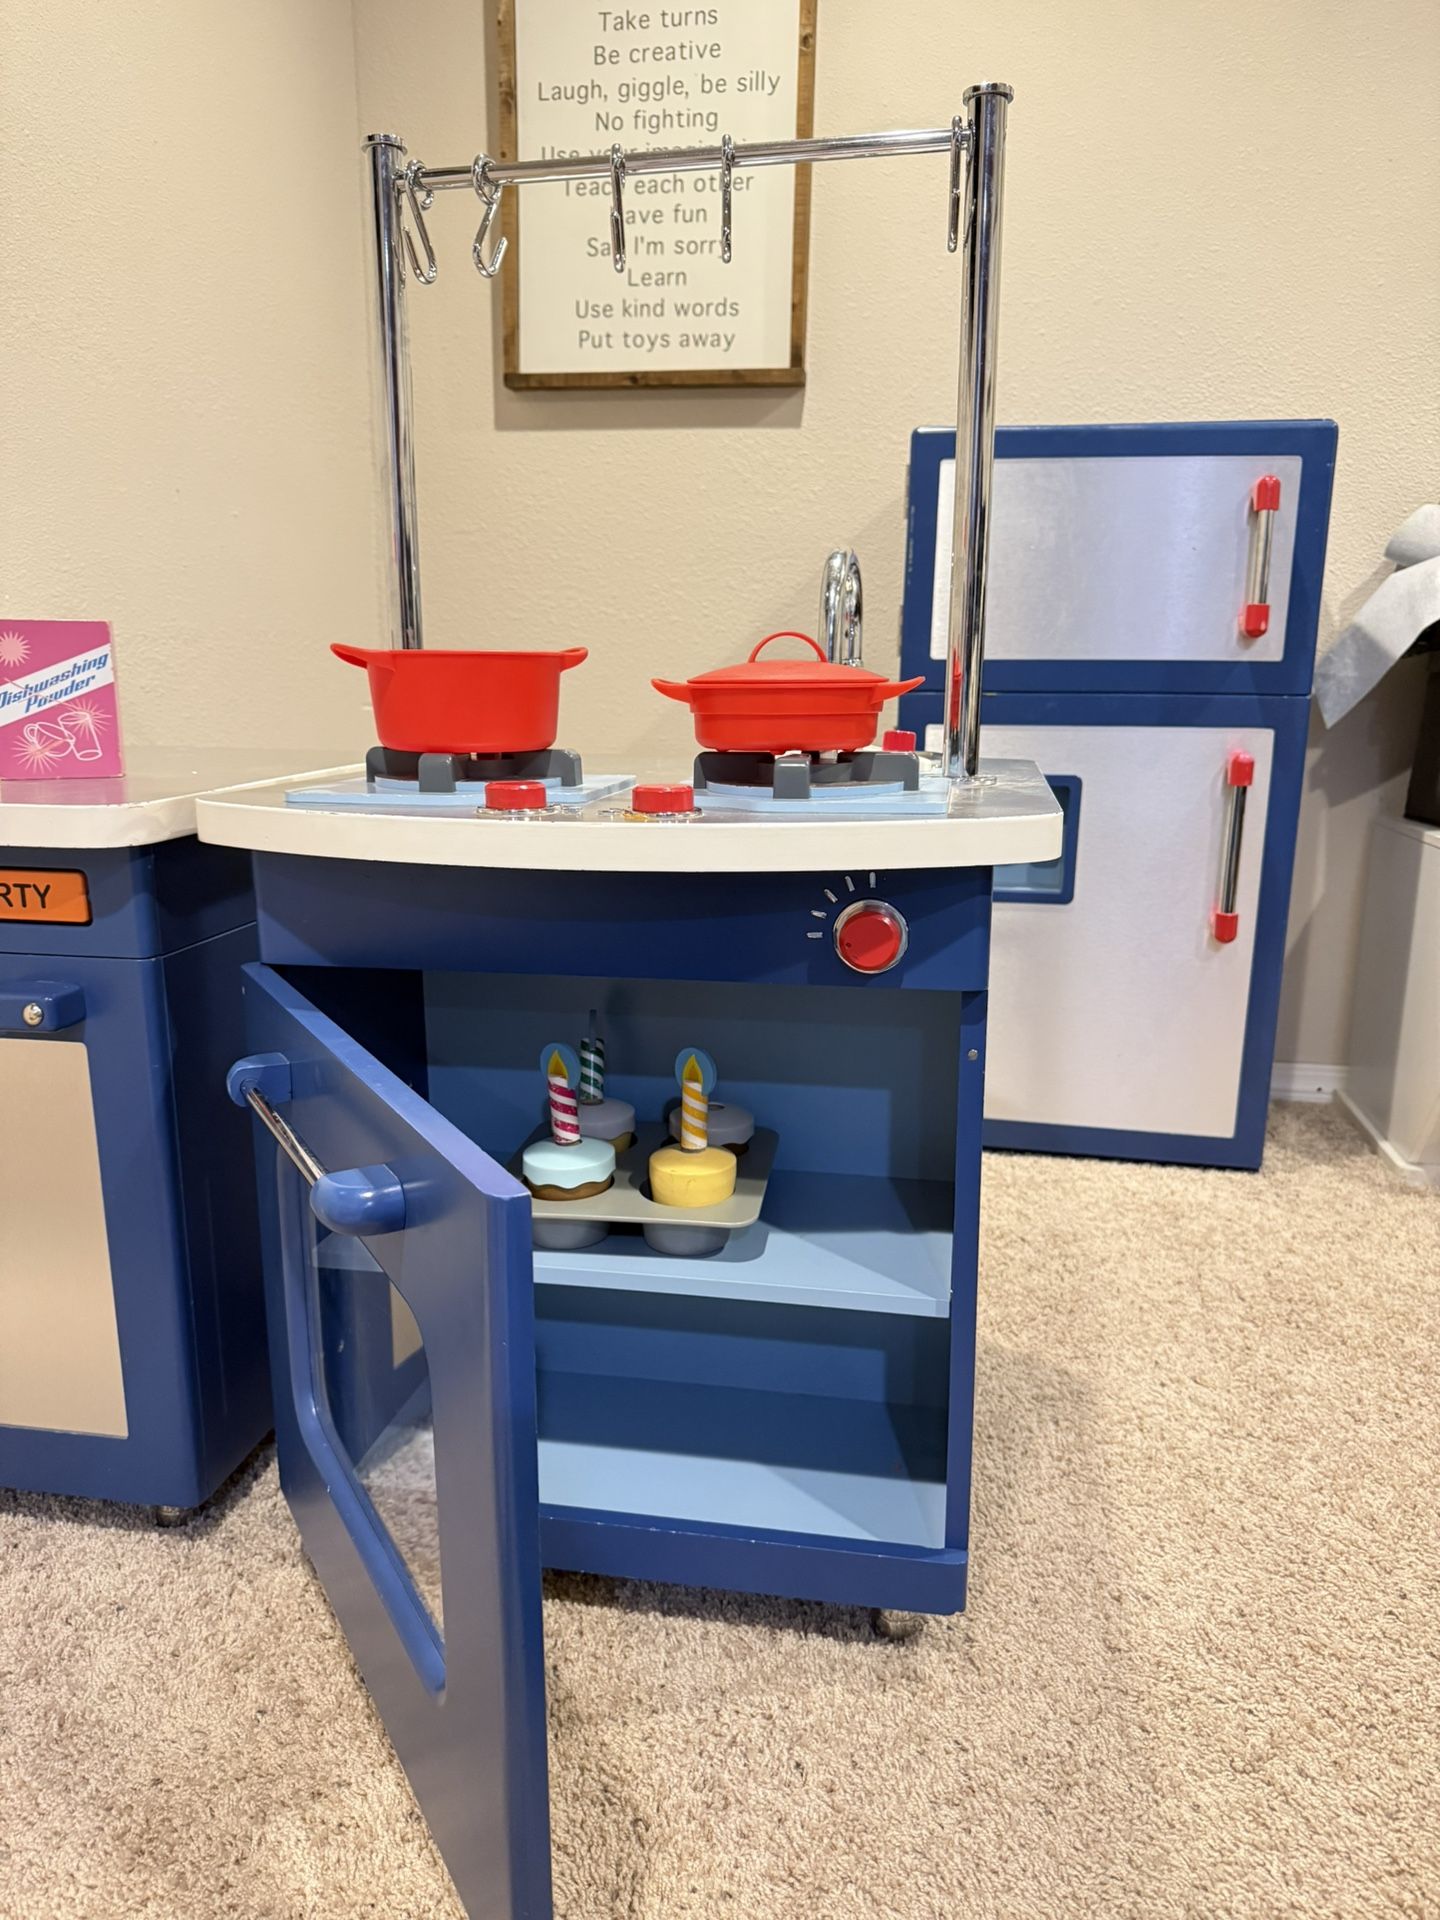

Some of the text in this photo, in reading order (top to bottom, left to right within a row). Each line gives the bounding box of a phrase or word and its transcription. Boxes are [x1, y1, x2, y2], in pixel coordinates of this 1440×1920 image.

[598, 8, 719, 32] Take turns
[593, 40, 722, 66] Be creative
[537, 70, 781, 104] Laugh, giggle, be silly
[595, 108, 719, 135] No fighting
[564, 178, 624, 197] Teac
[634, 173, 685, 195] each
[611, 203, 707, 225] ave fun
[586, 235, 727, 259] Sa I'm sorr
[627, 268, 687, 287] Learn
[575, 297, 740, 319] Use kind words
[578, 330, 736, 352] Put toys away
[25, 675, 96, 713] Powder
